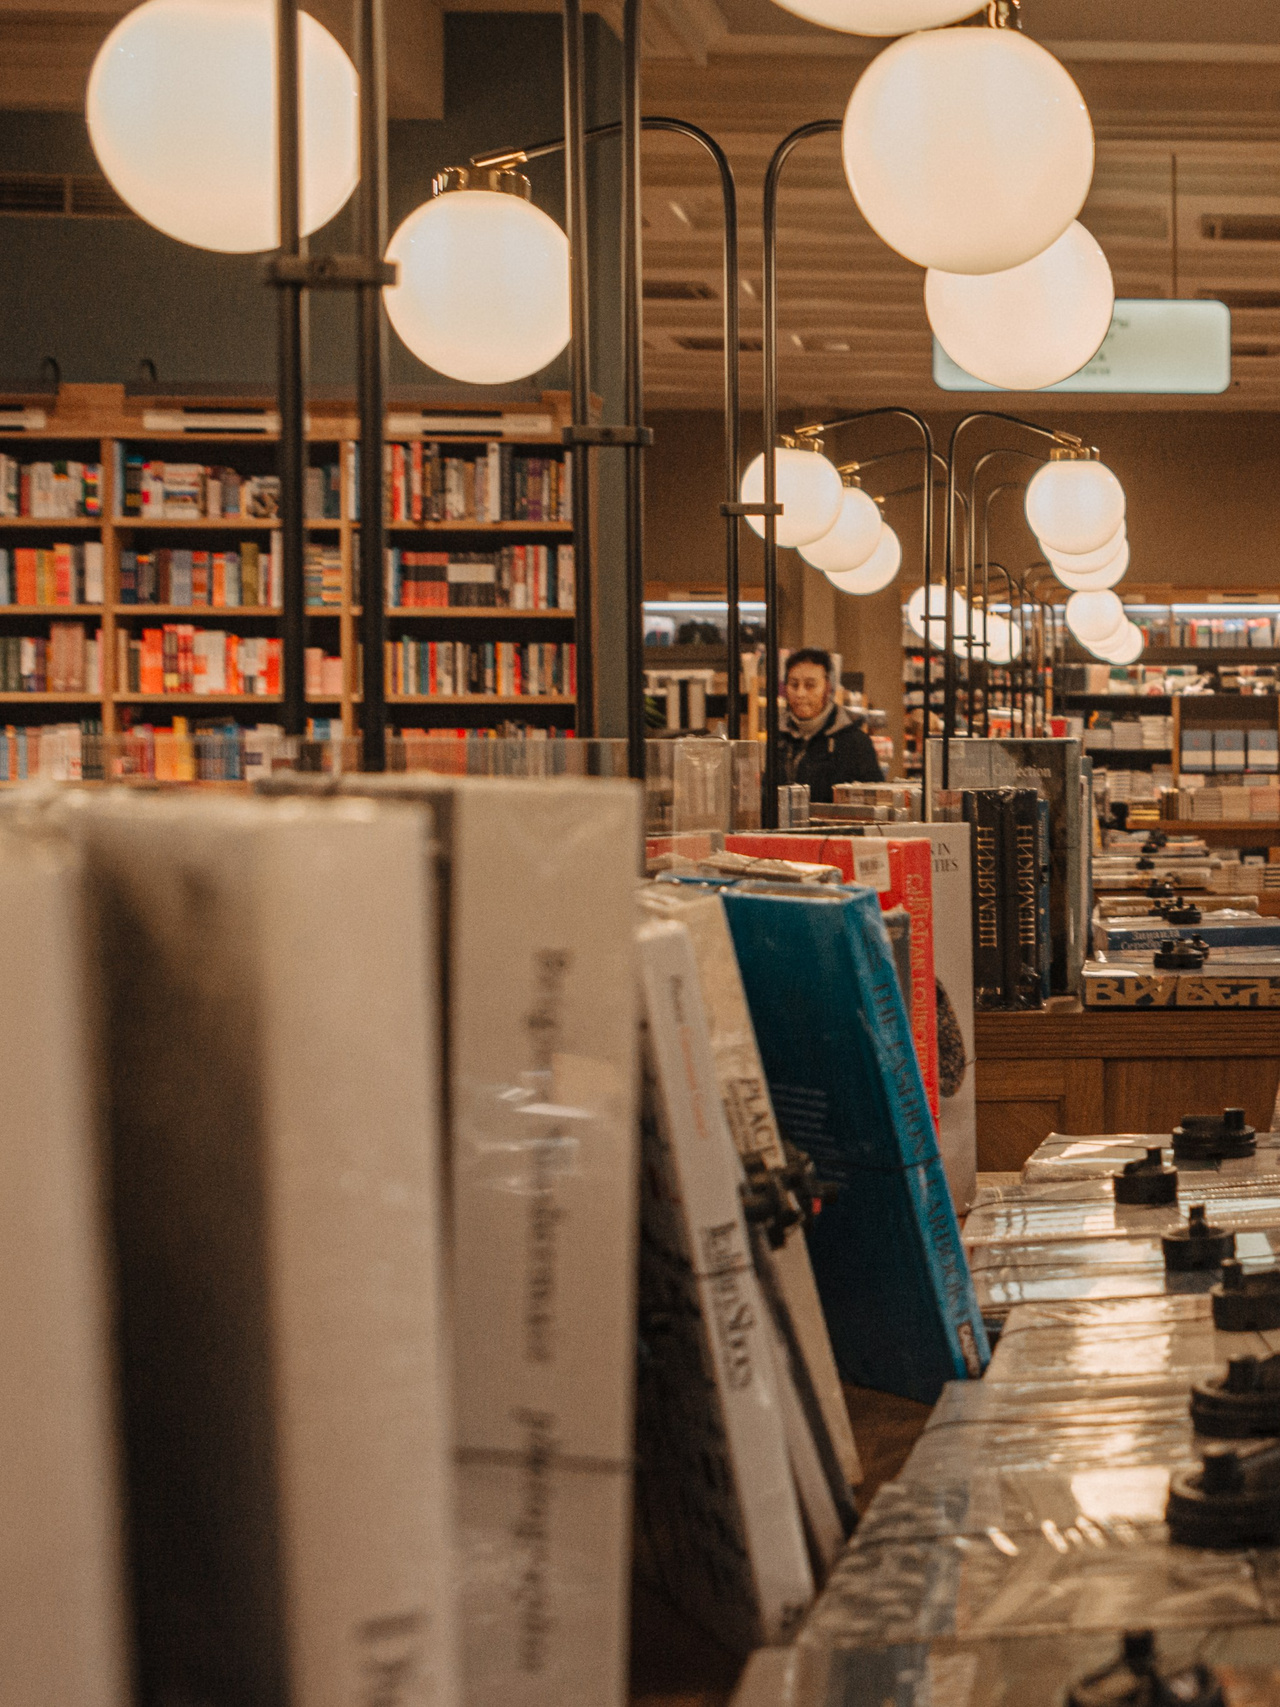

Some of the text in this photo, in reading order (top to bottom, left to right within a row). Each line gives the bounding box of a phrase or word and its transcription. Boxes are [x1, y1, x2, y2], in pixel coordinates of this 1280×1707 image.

[977, 826, 998, 948] ШЕМЯКИН
[1016, 825, 1037, 946] ШЕМЯКИН
[873, 982, 898, 1025] THE
[885, 1039, 928, 1157] FASHION
